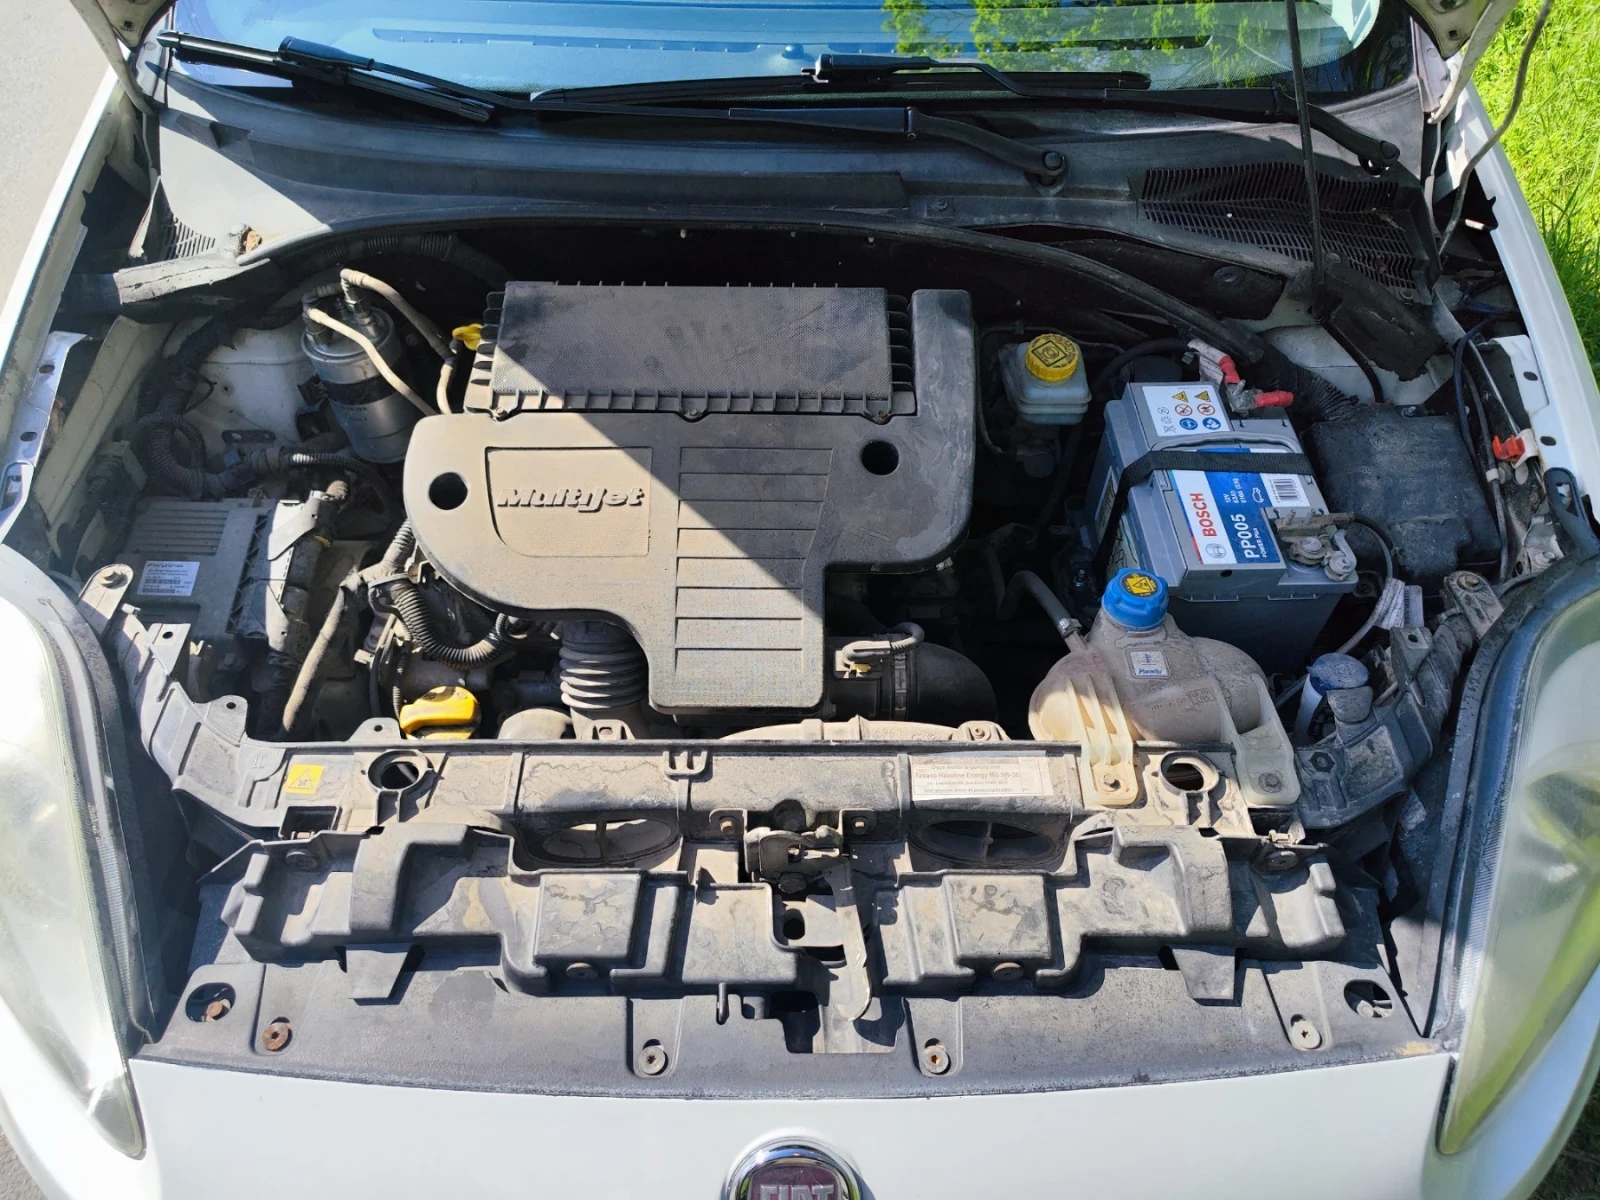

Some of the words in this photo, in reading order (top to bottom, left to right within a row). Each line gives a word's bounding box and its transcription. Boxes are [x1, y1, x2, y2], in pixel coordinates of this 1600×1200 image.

[1189, 493, 1217, 537] BOSCH
[1231, 513, 1260, 559] PP005
[1252, 527, 1262, 539] Plus
[1257, 539, 1268, 558] POWER
[966, 772, 988, 780] Energy
